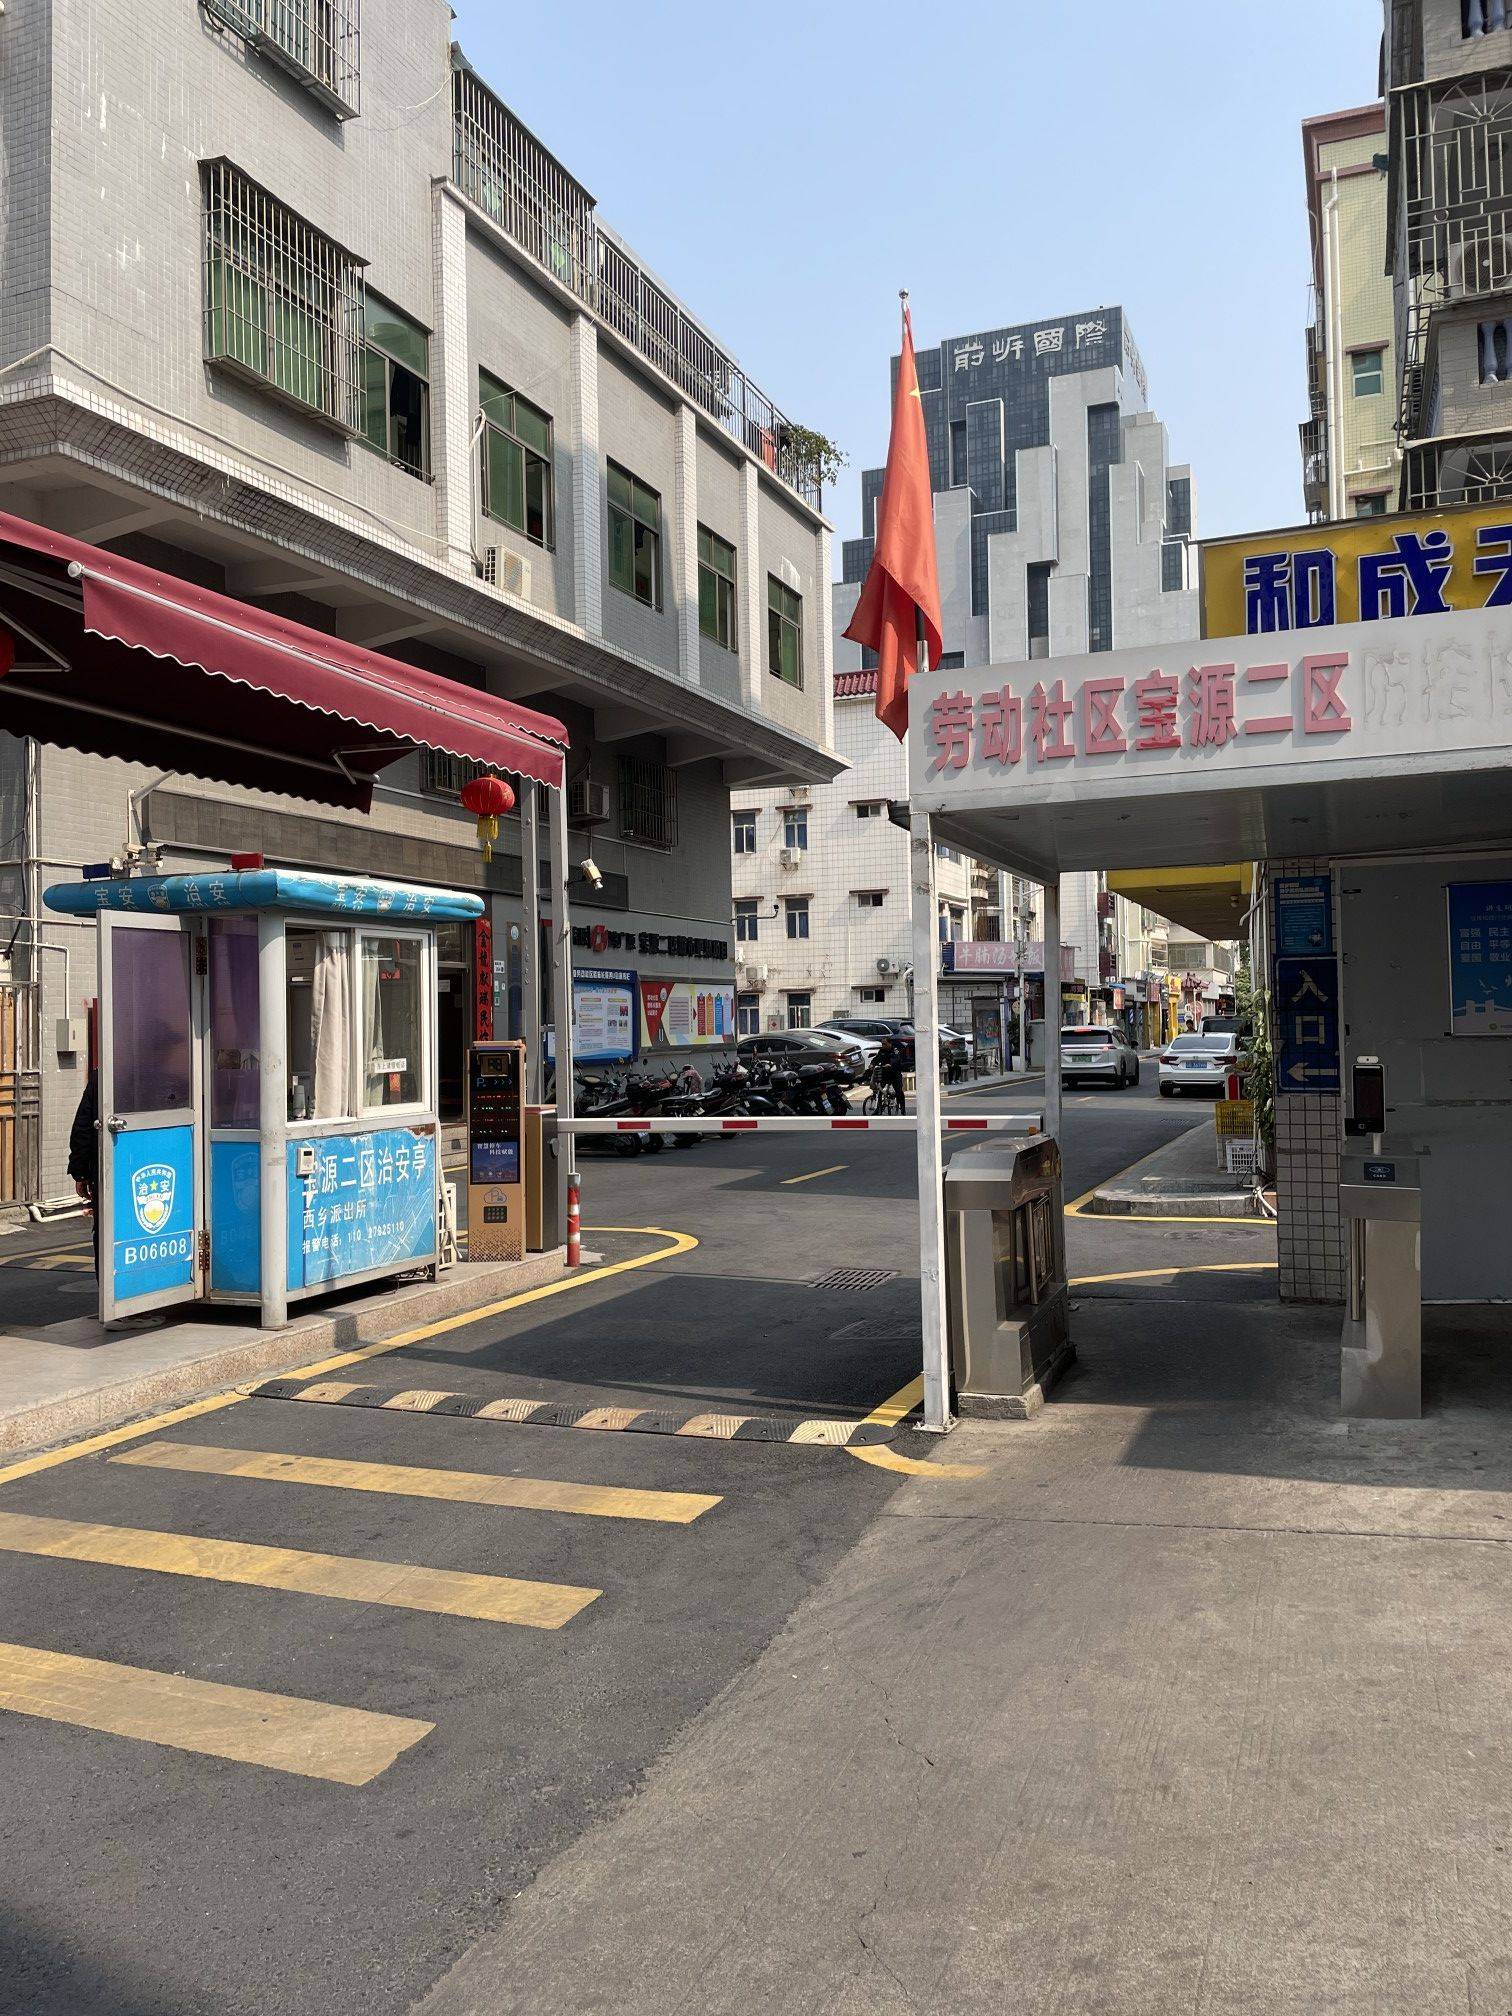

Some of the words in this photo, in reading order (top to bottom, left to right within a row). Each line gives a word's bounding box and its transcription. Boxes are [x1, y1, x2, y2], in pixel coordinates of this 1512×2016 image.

[933, 652, 1351, 771] 劳动社区宝源二区
[95, 886, 133, 906] 宝安
[184, 881, 226, 903] 治安
[1291, 969, 1329, 1045] 入口
[303, 1199, 366, 1229] 西乡派出所
[348, 1229, 361, 1242] 110
[125, 1238, 187, 1265] B06608
